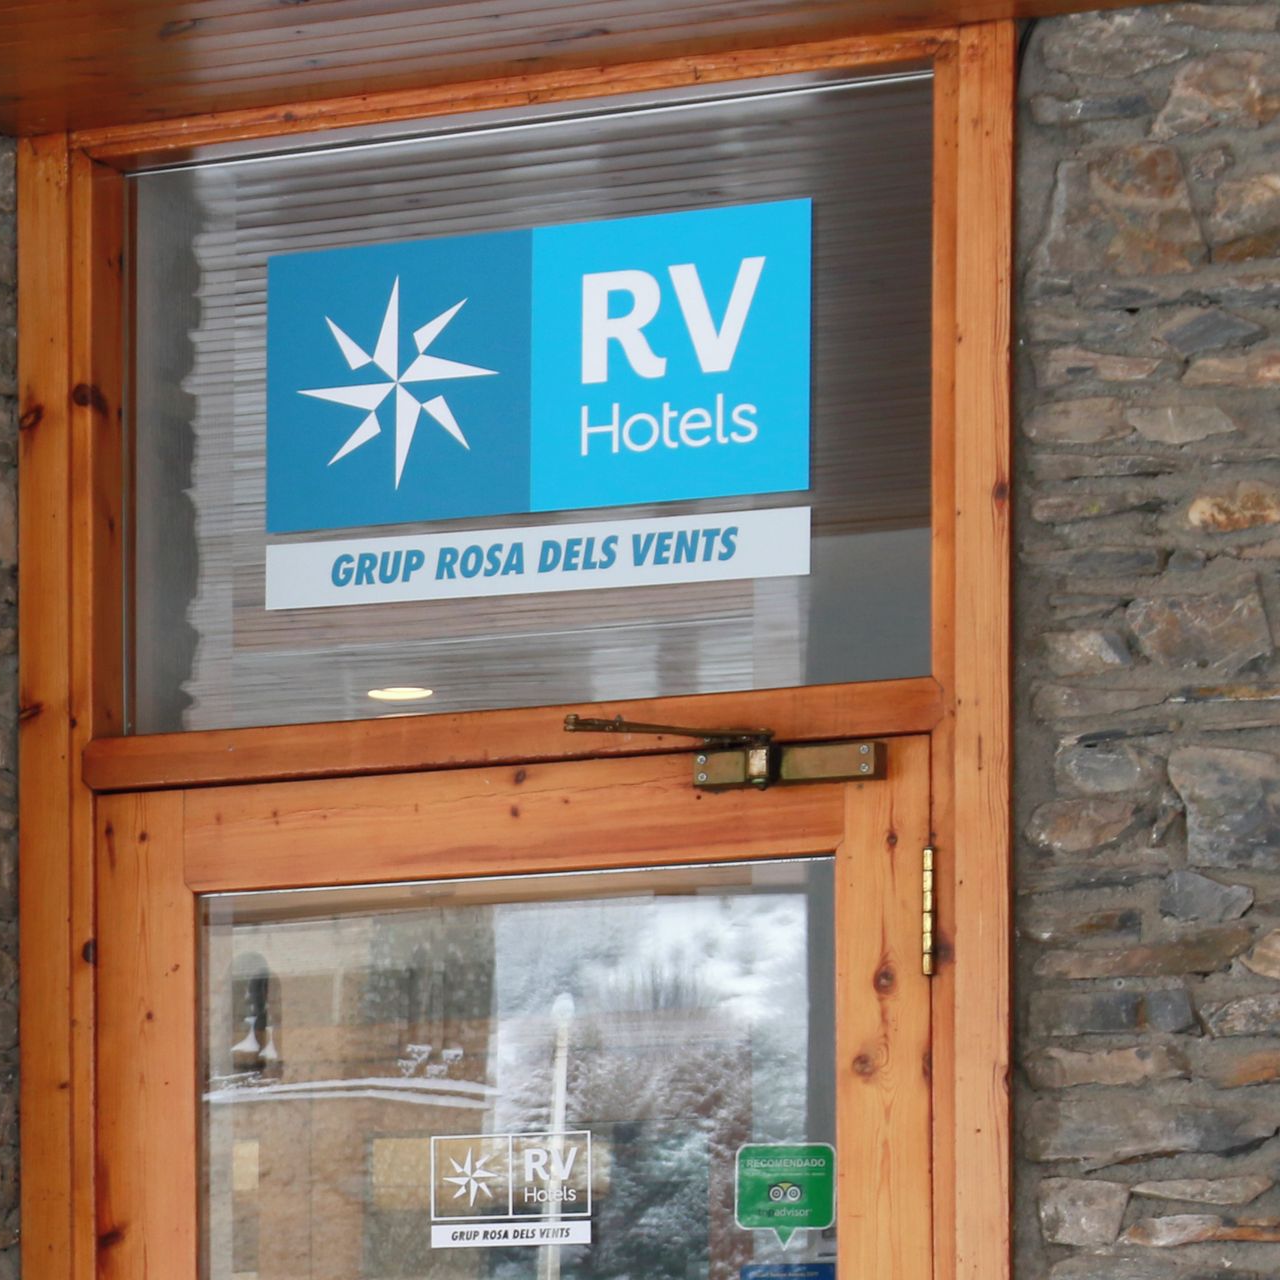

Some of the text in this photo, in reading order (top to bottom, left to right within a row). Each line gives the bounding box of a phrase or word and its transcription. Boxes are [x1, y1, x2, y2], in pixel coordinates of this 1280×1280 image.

[581, 255, 767, 384] RV
[580, 393, 758, 456] Hotels
[330, 526, 739, 588] GRUP ROSA DELS VENTS
[524, 1146, 578, 1182] RV
[746, 1158, 826, 1168] RECOMENDADO
[524, 1186, 577, 1203] Hotels
[451, 1227, 571, 1241] GRUP ROSA DELS VENTS
